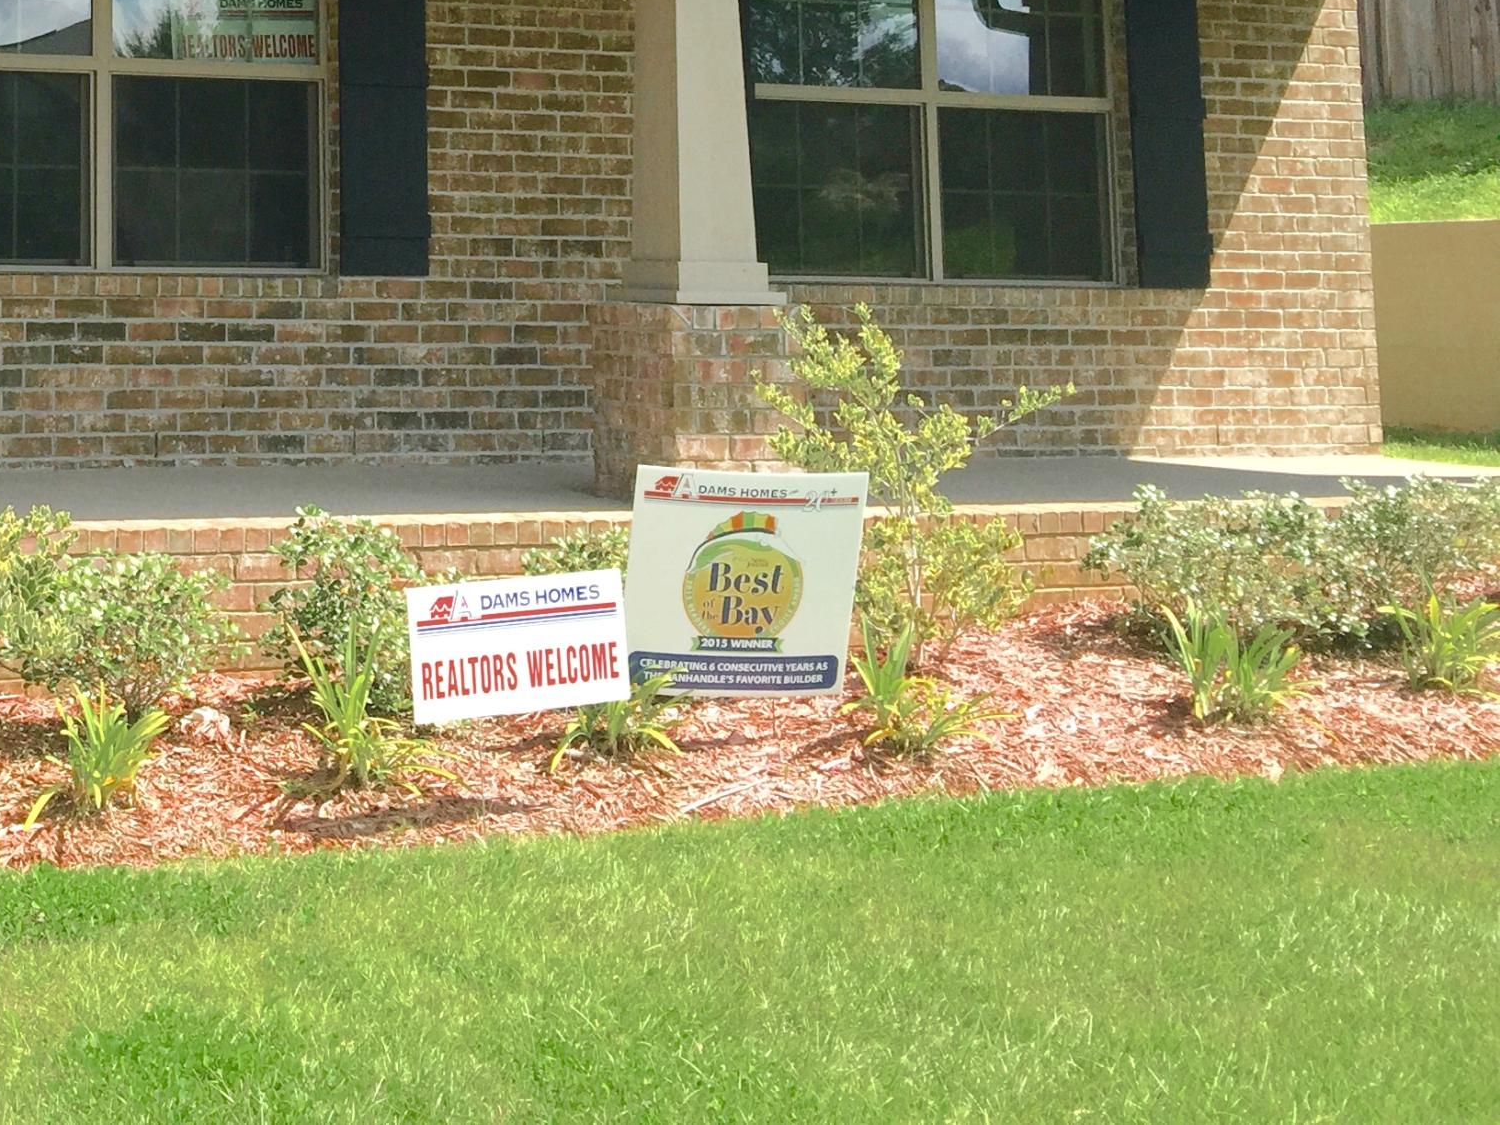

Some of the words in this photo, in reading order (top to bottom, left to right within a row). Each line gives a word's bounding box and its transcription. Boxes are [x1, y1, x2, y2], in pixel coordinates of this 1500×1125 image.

[251, 34, 316, 58] WELCOME
[740, 487, 788, 499] HOMES
[706, 561, 784, 596] Best
[535, 584, 601, 605] HOMES
[702, 598, 716, 609] of
[719, 595, 782, 635] Bay
[701, 638, 728, 649] 2015
[730, 639, 774, 650] WINNER
[421, 652, 519, 701] REALTORS
[526, 641, 620, 688] WELCOME
[639, 658, 708, 672] CELEBRATING
[708, 662, 716, 672] 6
[717, 663, 785, 673] CONSECUTIVE
[785, 662, 815, 673] YEARS
[815, 661, 829, 672] AS
[667, 673, 735, 684] ANHANDLE'S
[736, 675, 782, 685] FAVORITE
[783, 675, 824, 685] BUILDER
